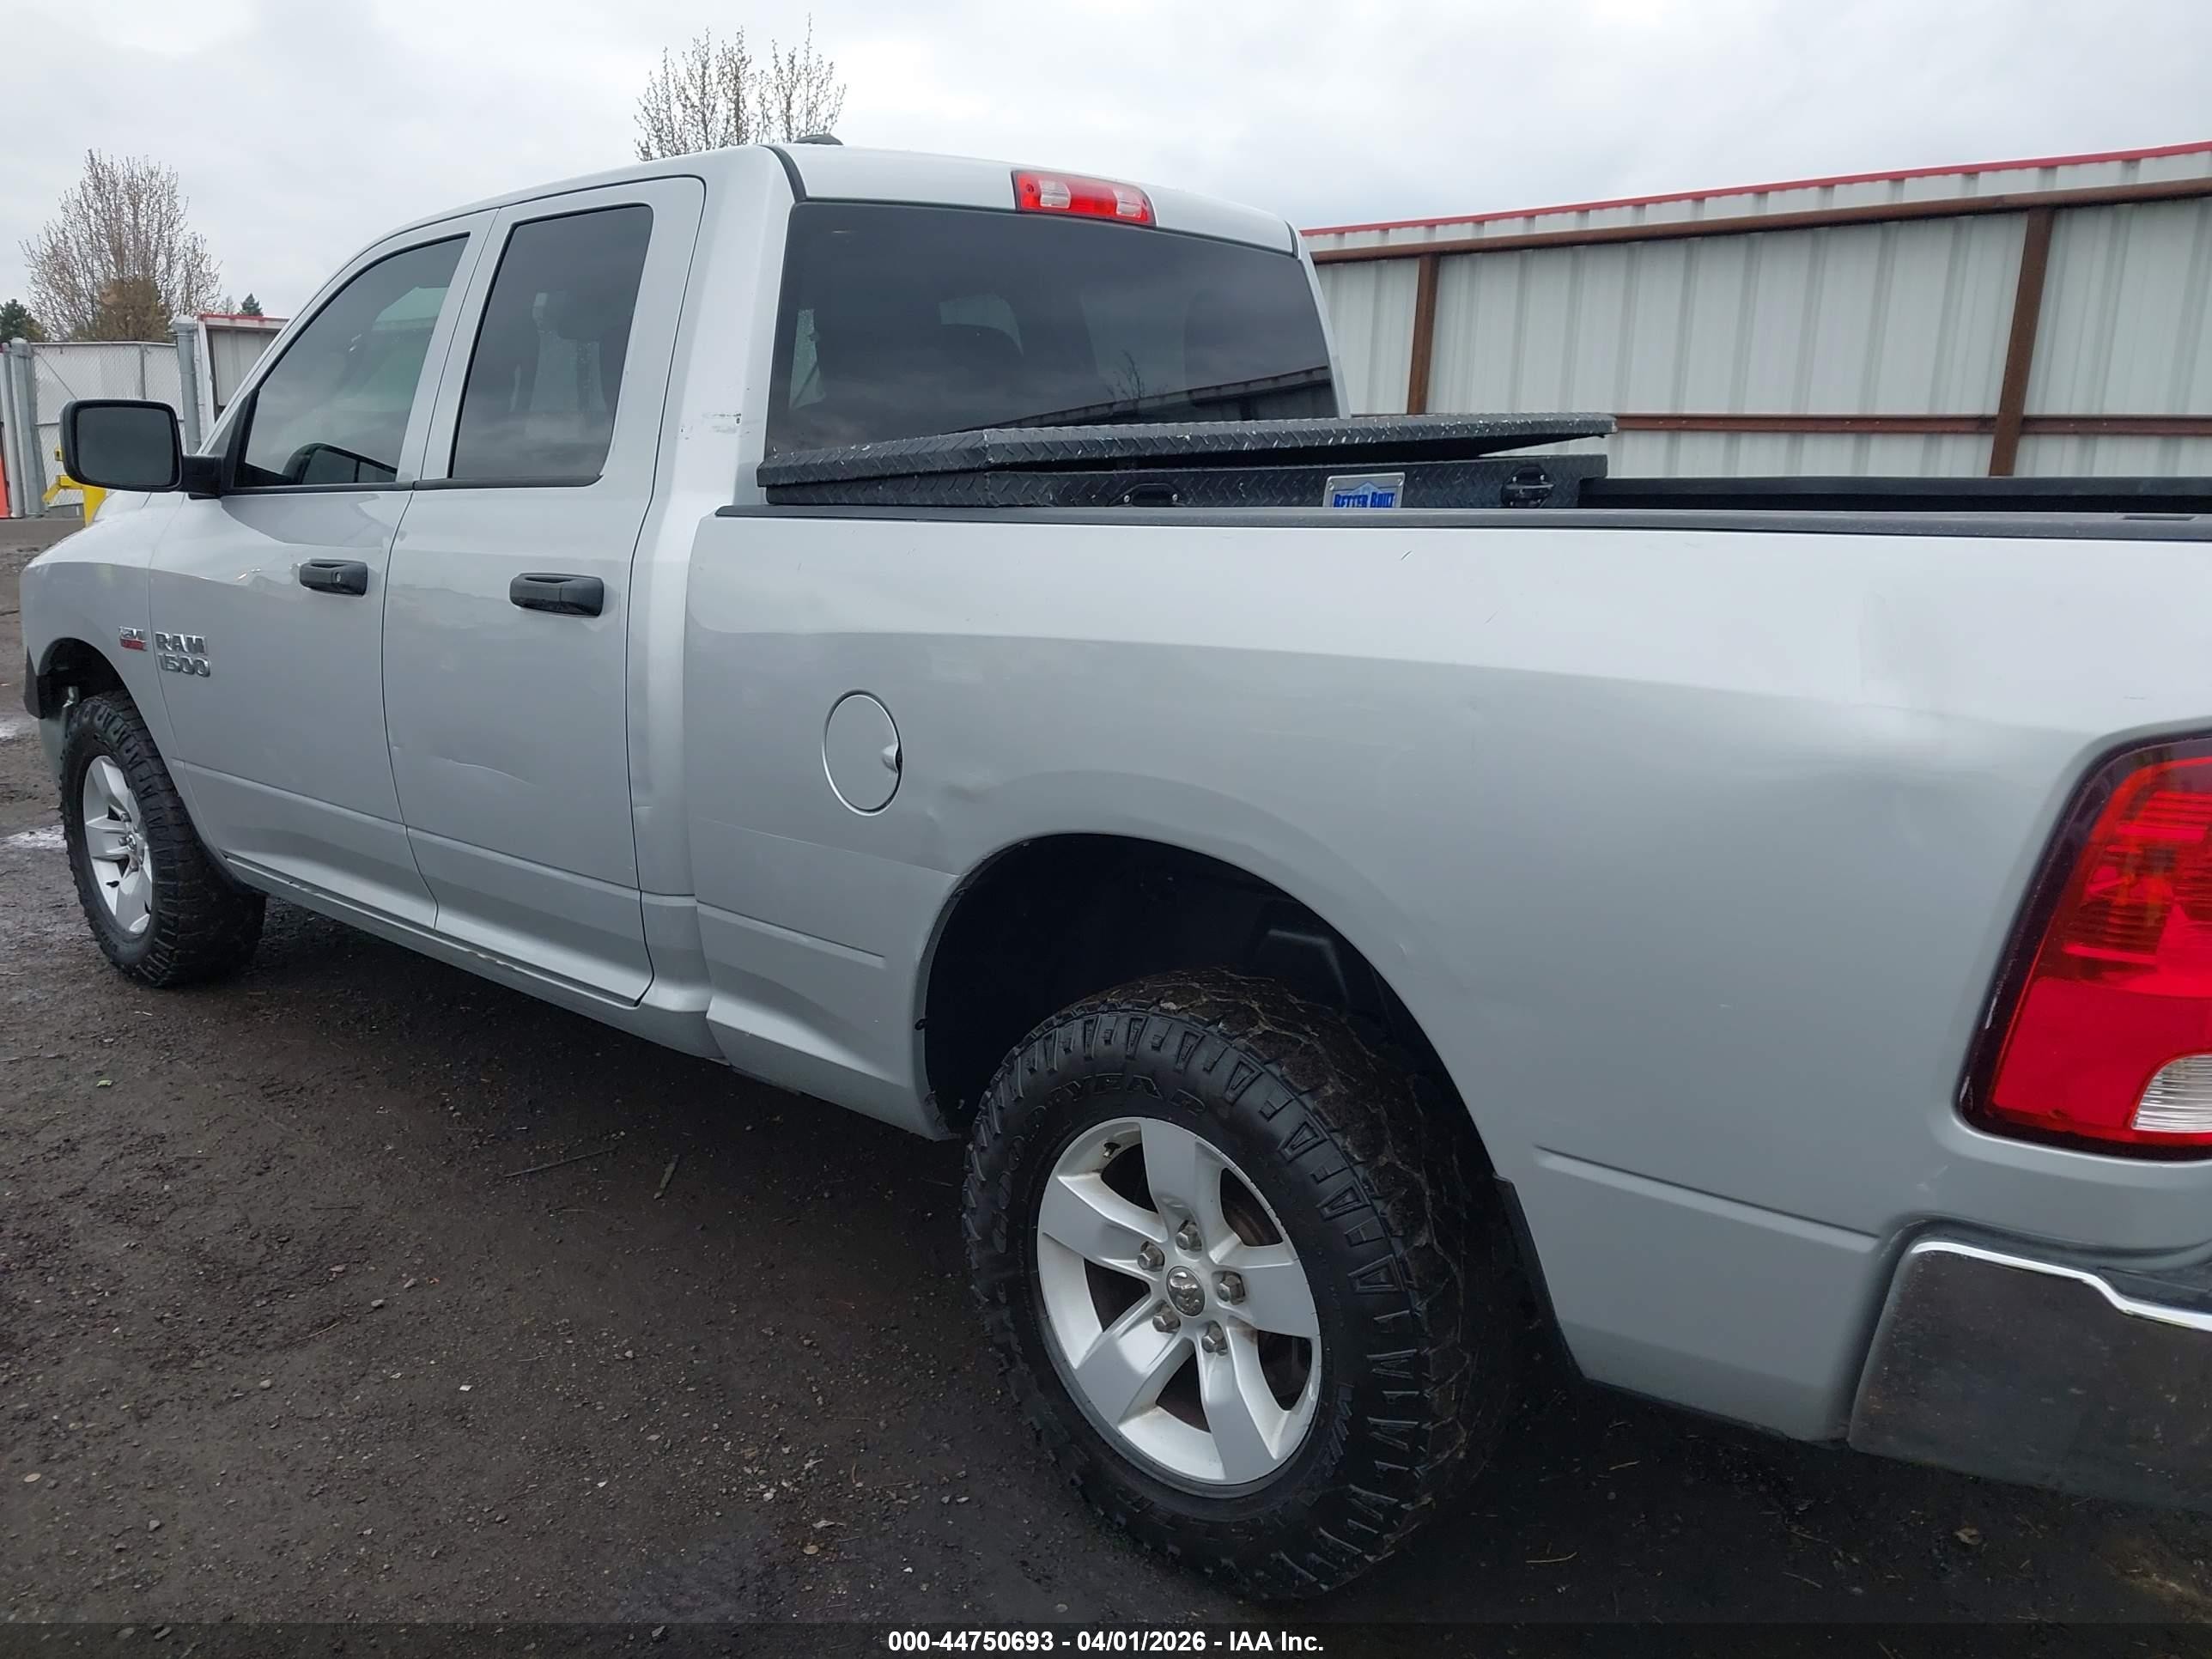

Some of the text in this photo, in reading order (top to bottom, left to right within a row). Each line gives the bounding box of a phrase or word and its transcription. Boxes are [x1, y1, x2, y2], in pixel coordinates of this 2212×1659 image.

[1334, 492, 1395, 508] BETTER BUILT
[155, 631, 208, 654] RAM
[158, 653, 211, 678] 1500
